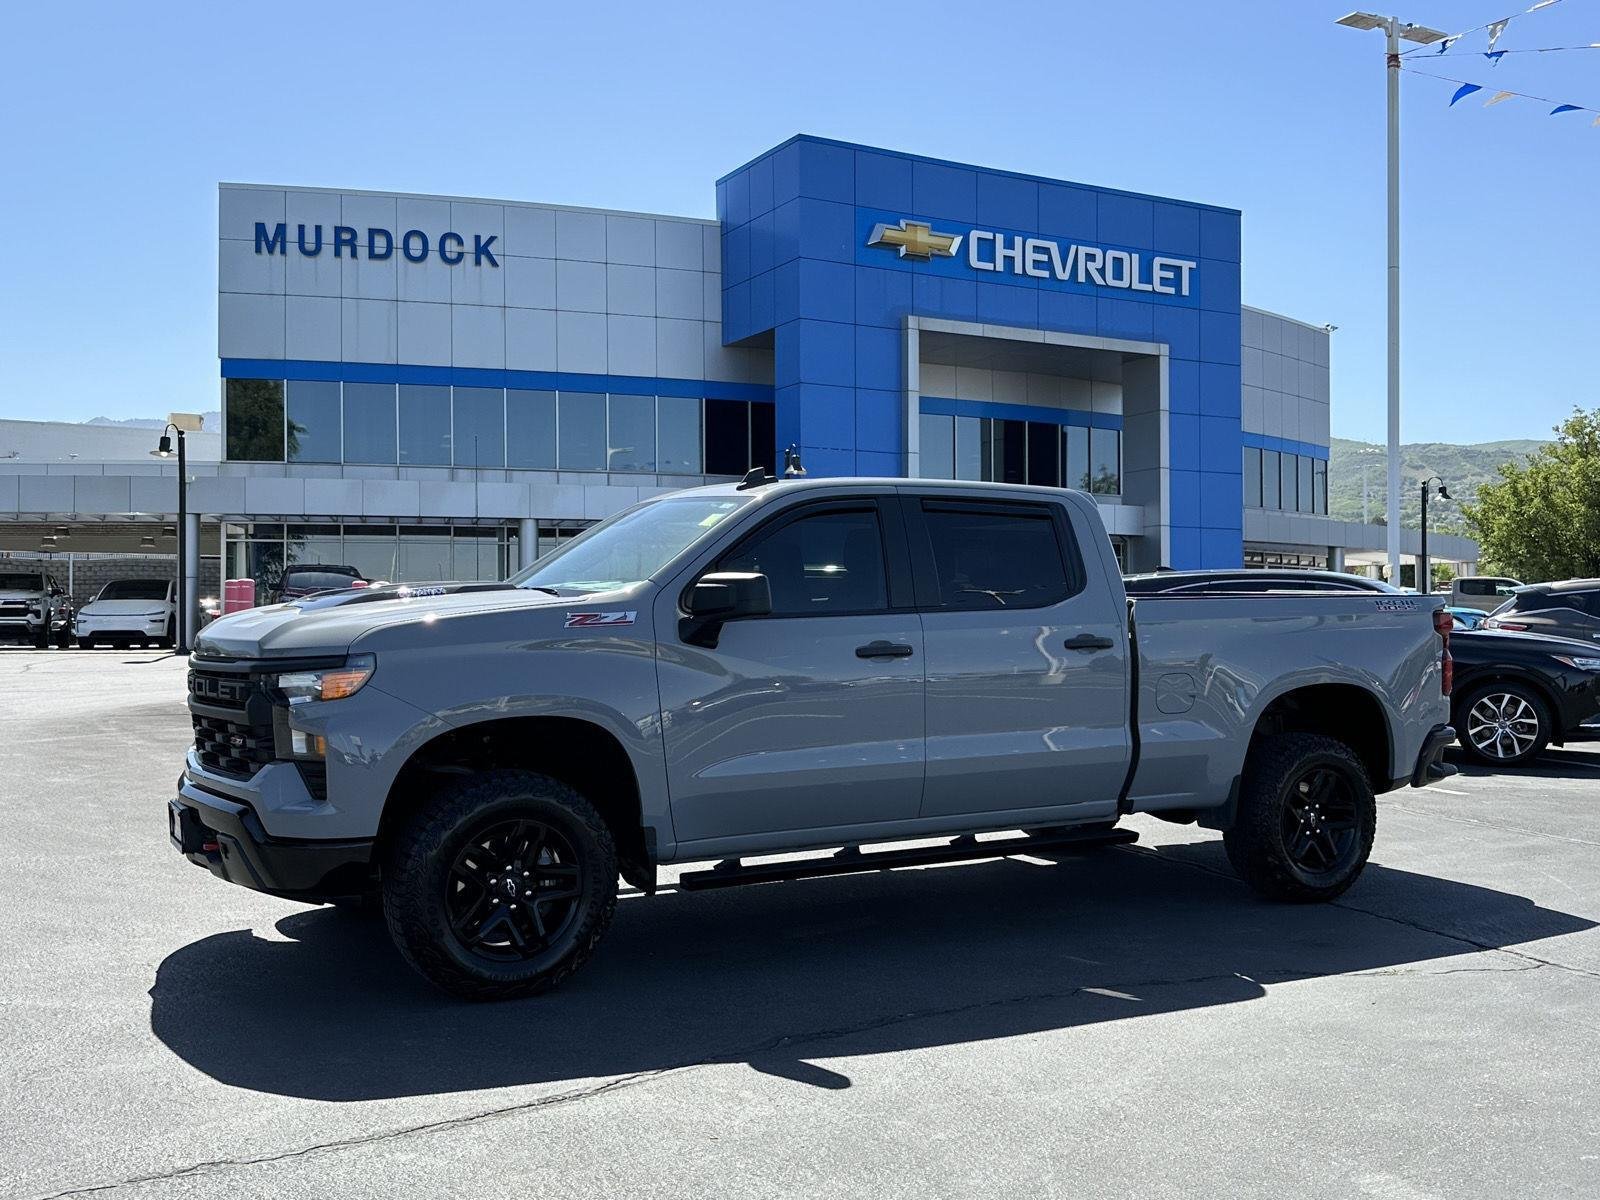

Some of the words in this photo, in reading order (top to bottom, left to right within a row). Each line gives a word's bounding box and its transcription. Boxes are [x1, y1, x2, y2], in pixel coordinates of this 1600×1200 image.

[254, 222, 500, 267] MURDOCK
[969, 229, 1197, 296] CHEVROLET
[564, 611, 637, 628] Z71
